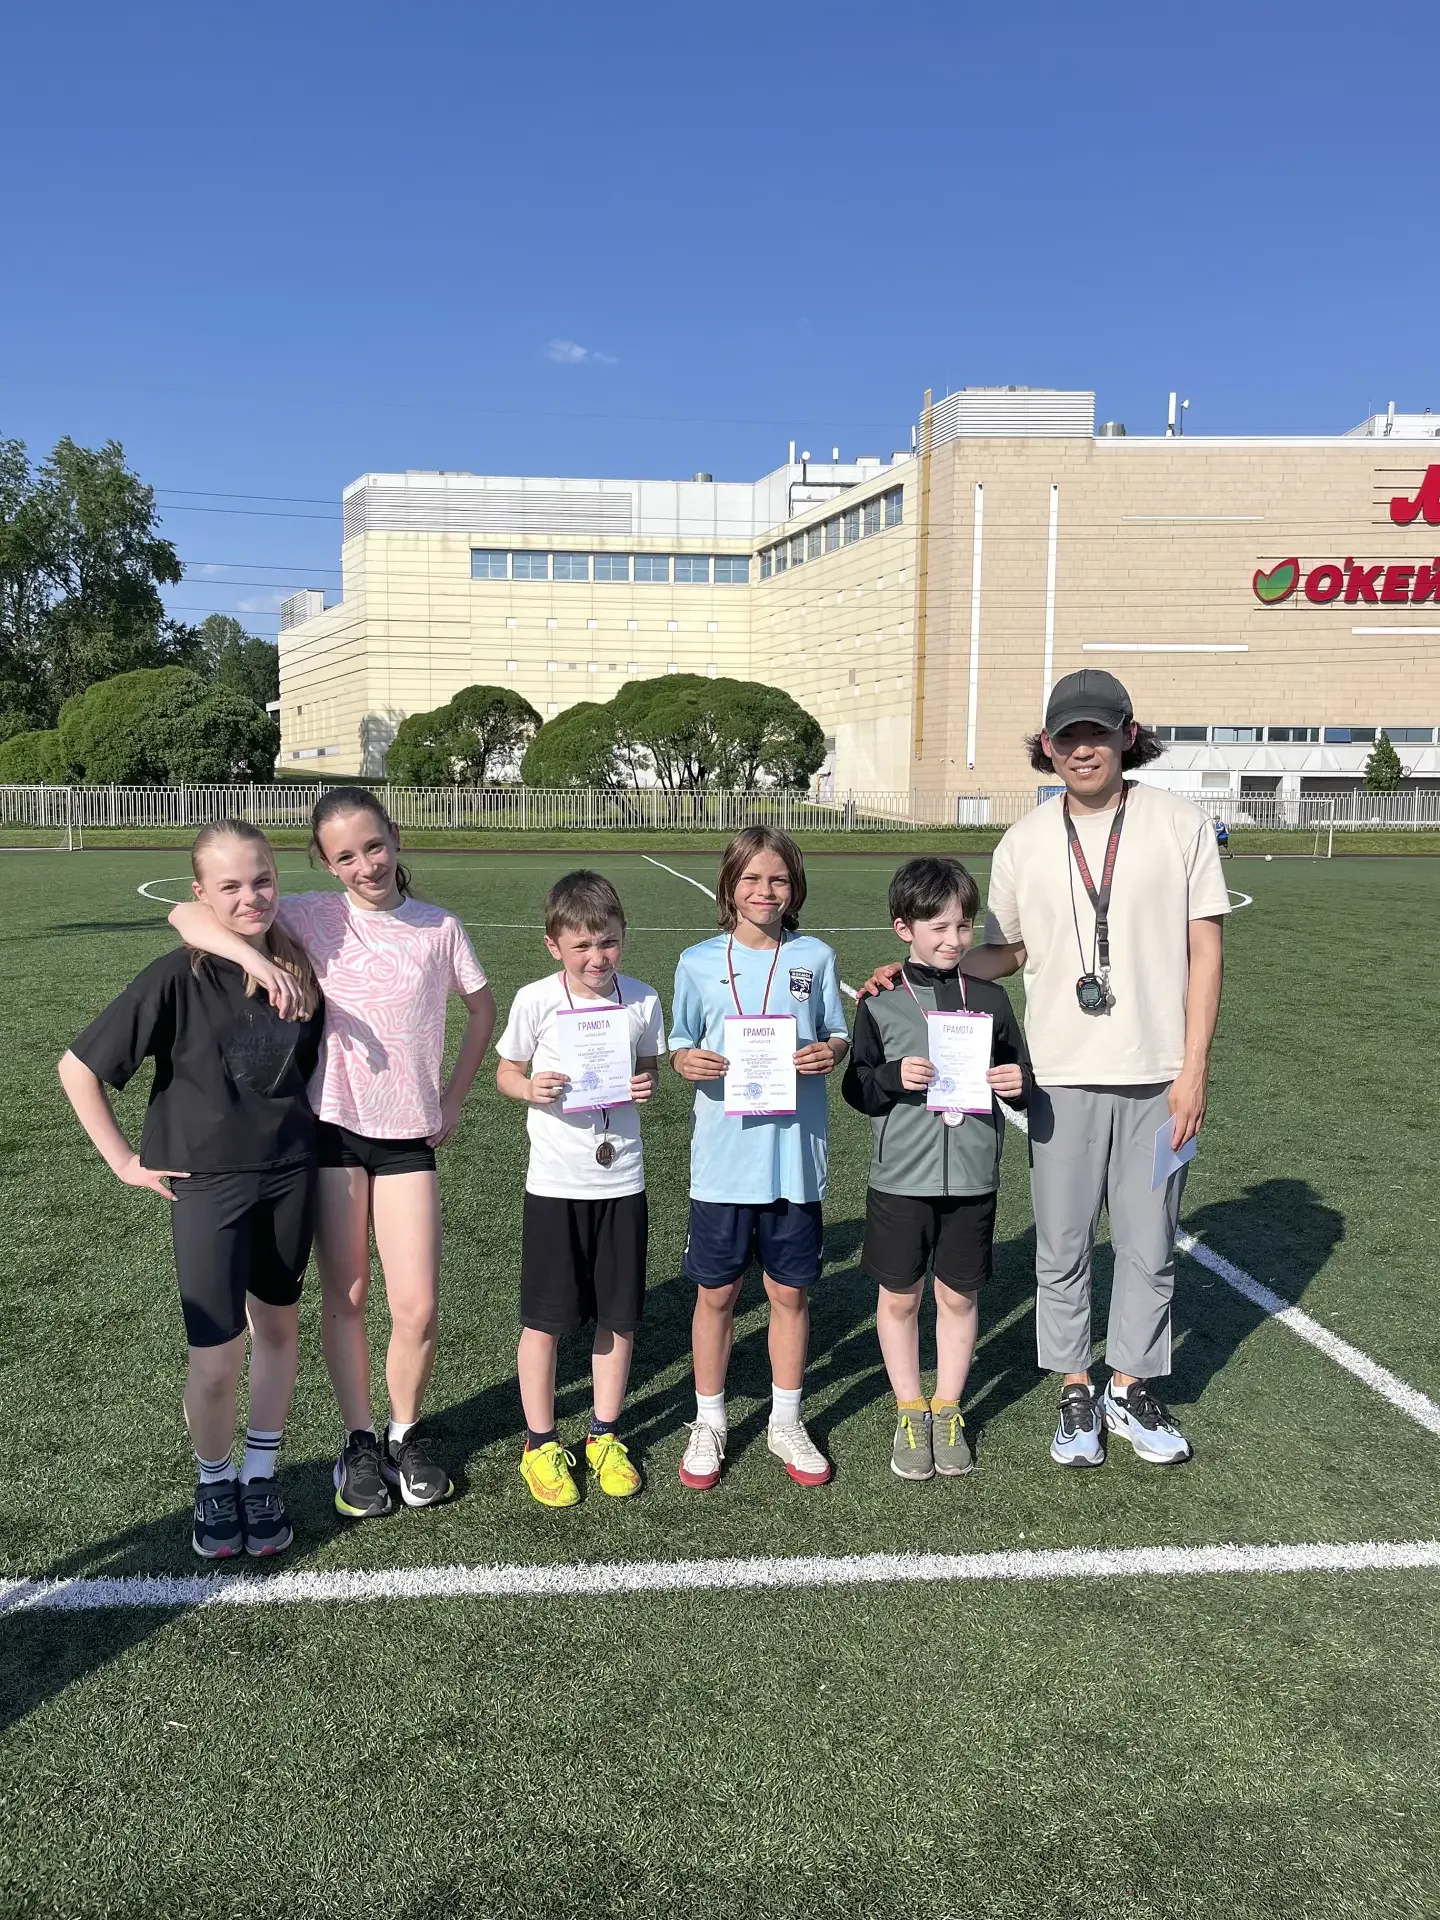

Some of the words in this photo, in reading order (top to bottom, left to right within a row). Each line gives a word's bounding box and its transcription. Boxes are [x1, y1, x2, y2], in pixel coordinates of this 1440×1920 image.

[578, 1020, 610, 1031] ГРАМОТА
[943, 1025, 973, 1034] ГРАМОТА
[743, 1028, 775, 1036] ГРАМОТА
